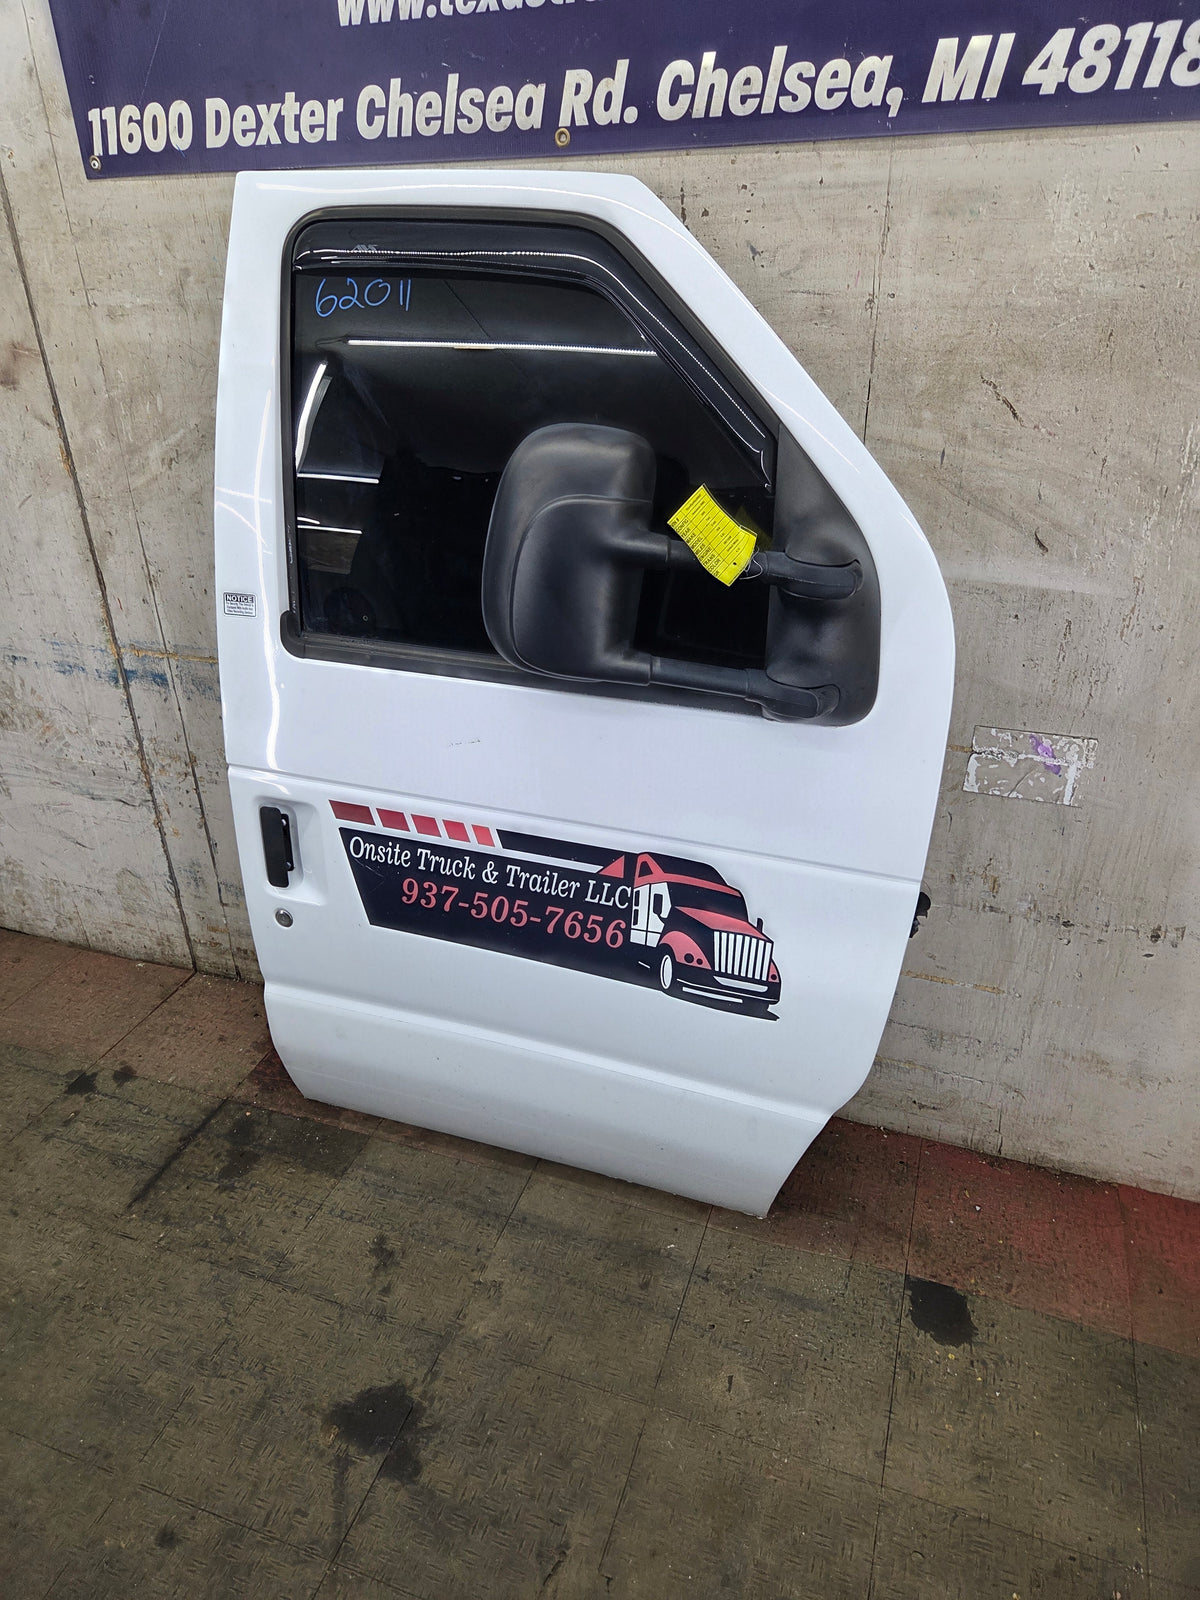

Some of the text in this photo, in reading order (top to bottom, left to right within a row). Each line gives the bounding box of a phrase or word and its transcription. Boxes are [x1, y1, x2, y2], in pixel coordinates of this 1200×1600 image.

[88, 101, 193, 157] 11600
[206, 92, 344, 149] Dexter
[356, 73, 546, 139] Chelsea
[557, 58, 639, 127] Rd.
[656, 45, 904, 120] Chelsea,
[921, 33, 1016, 103] MI
[315, 277, 411, 317] 62011
[226, 594, 254, 602] NOTICE
[349, 836, 632, 908] Onsite Truck & Trailer LLC
[401, 877, 625, 949] 937-505-7656
